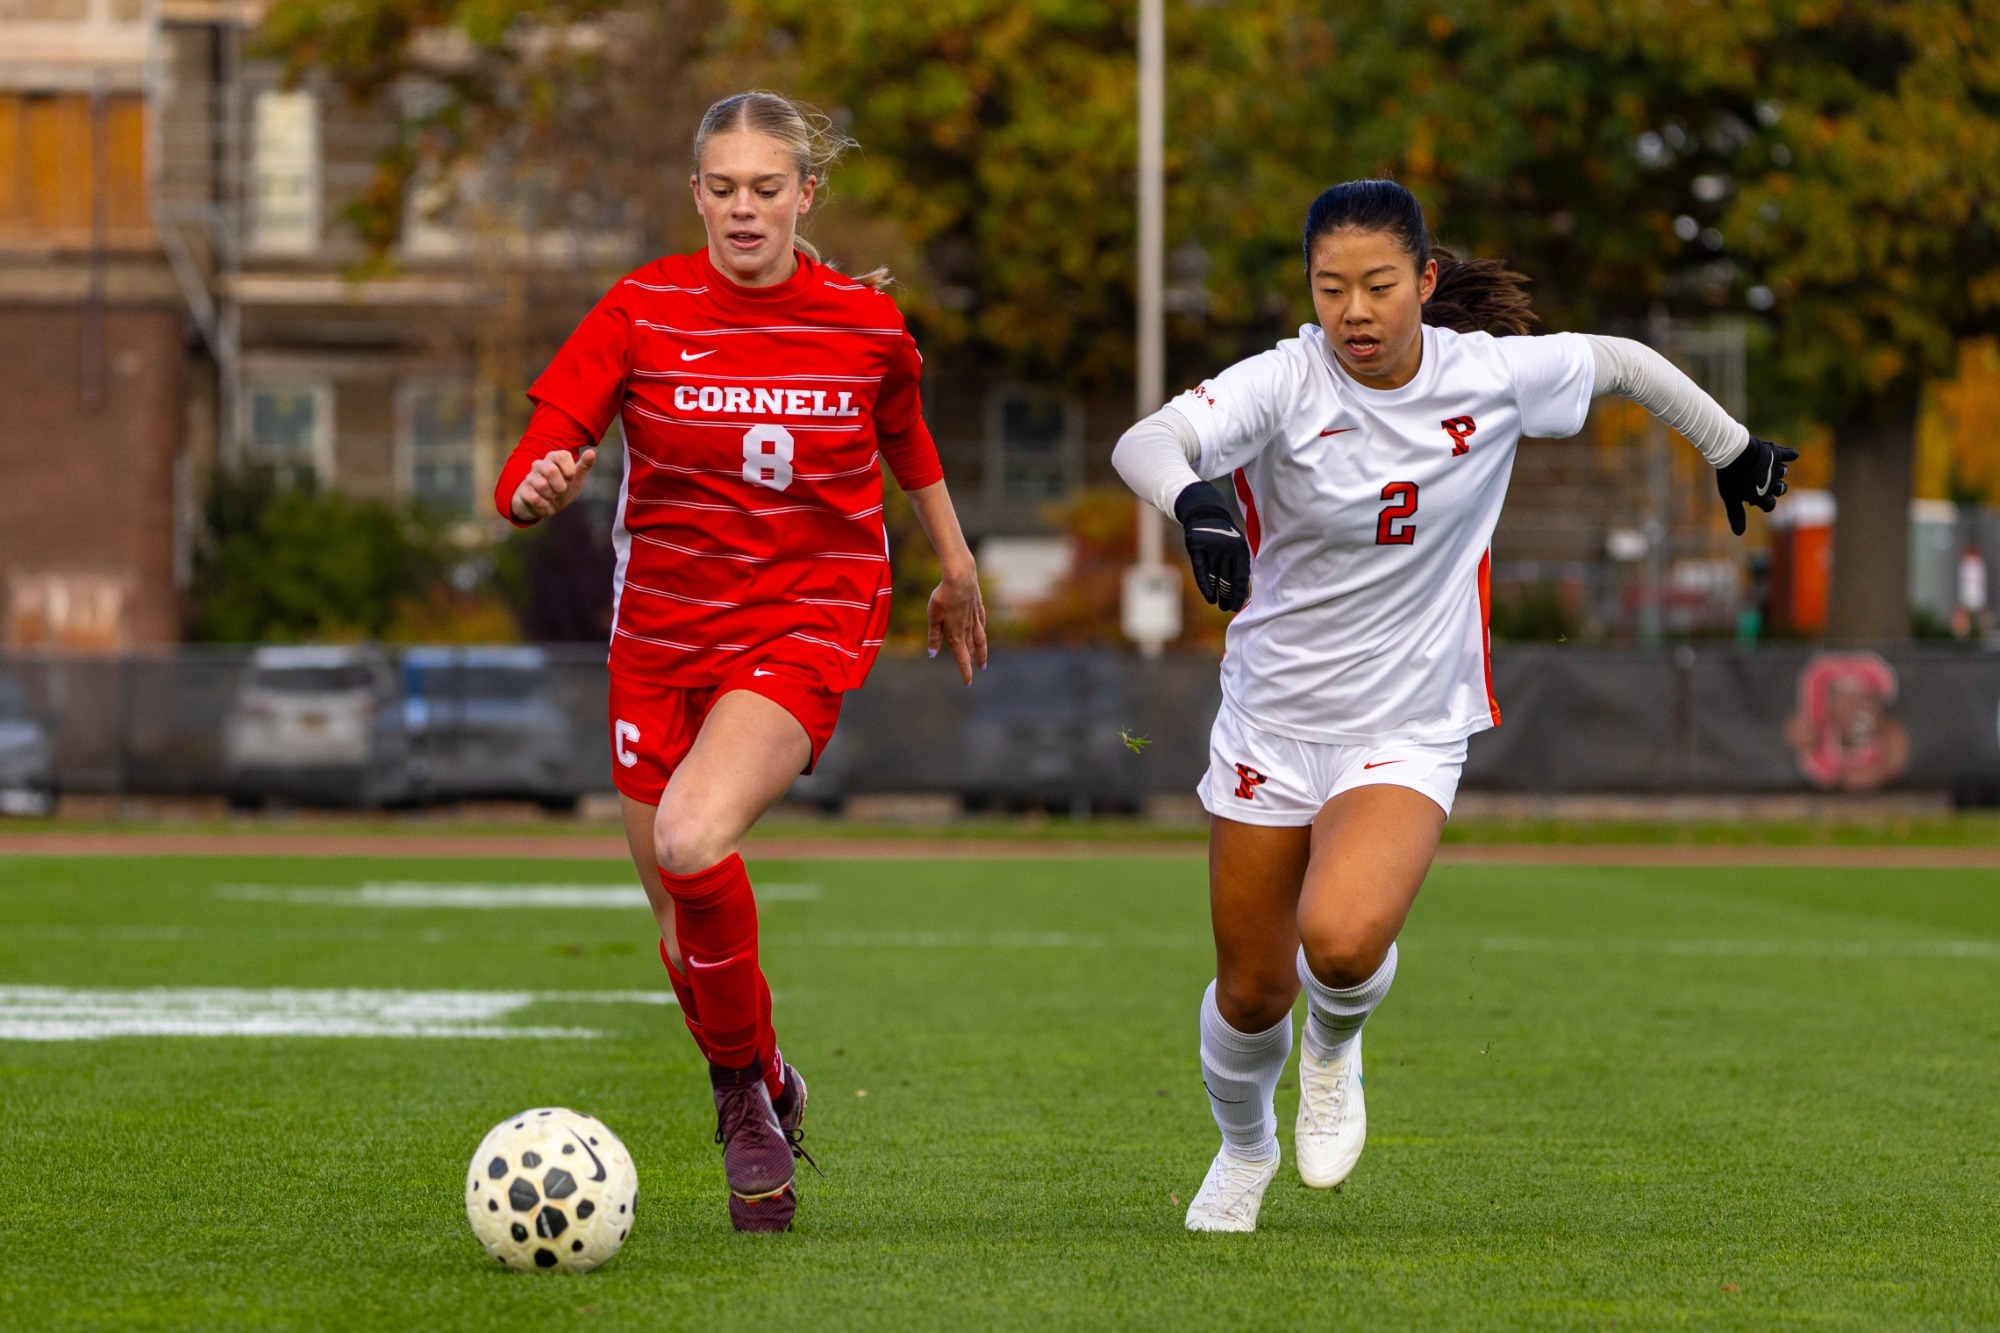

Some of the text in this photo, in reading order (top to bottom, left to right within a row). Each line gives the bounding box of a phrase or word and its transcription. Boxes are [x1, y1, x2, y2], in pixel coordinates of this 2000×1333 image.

[674, 385, 860, 417] CORNELL
[742, 424, 795, 492] 8
[1440, 415, 1477, 458] P
[1375, 481, 1420, 545] 2
[615, 719, 641, 769] C
[1234, 762, 1268, 801] P
